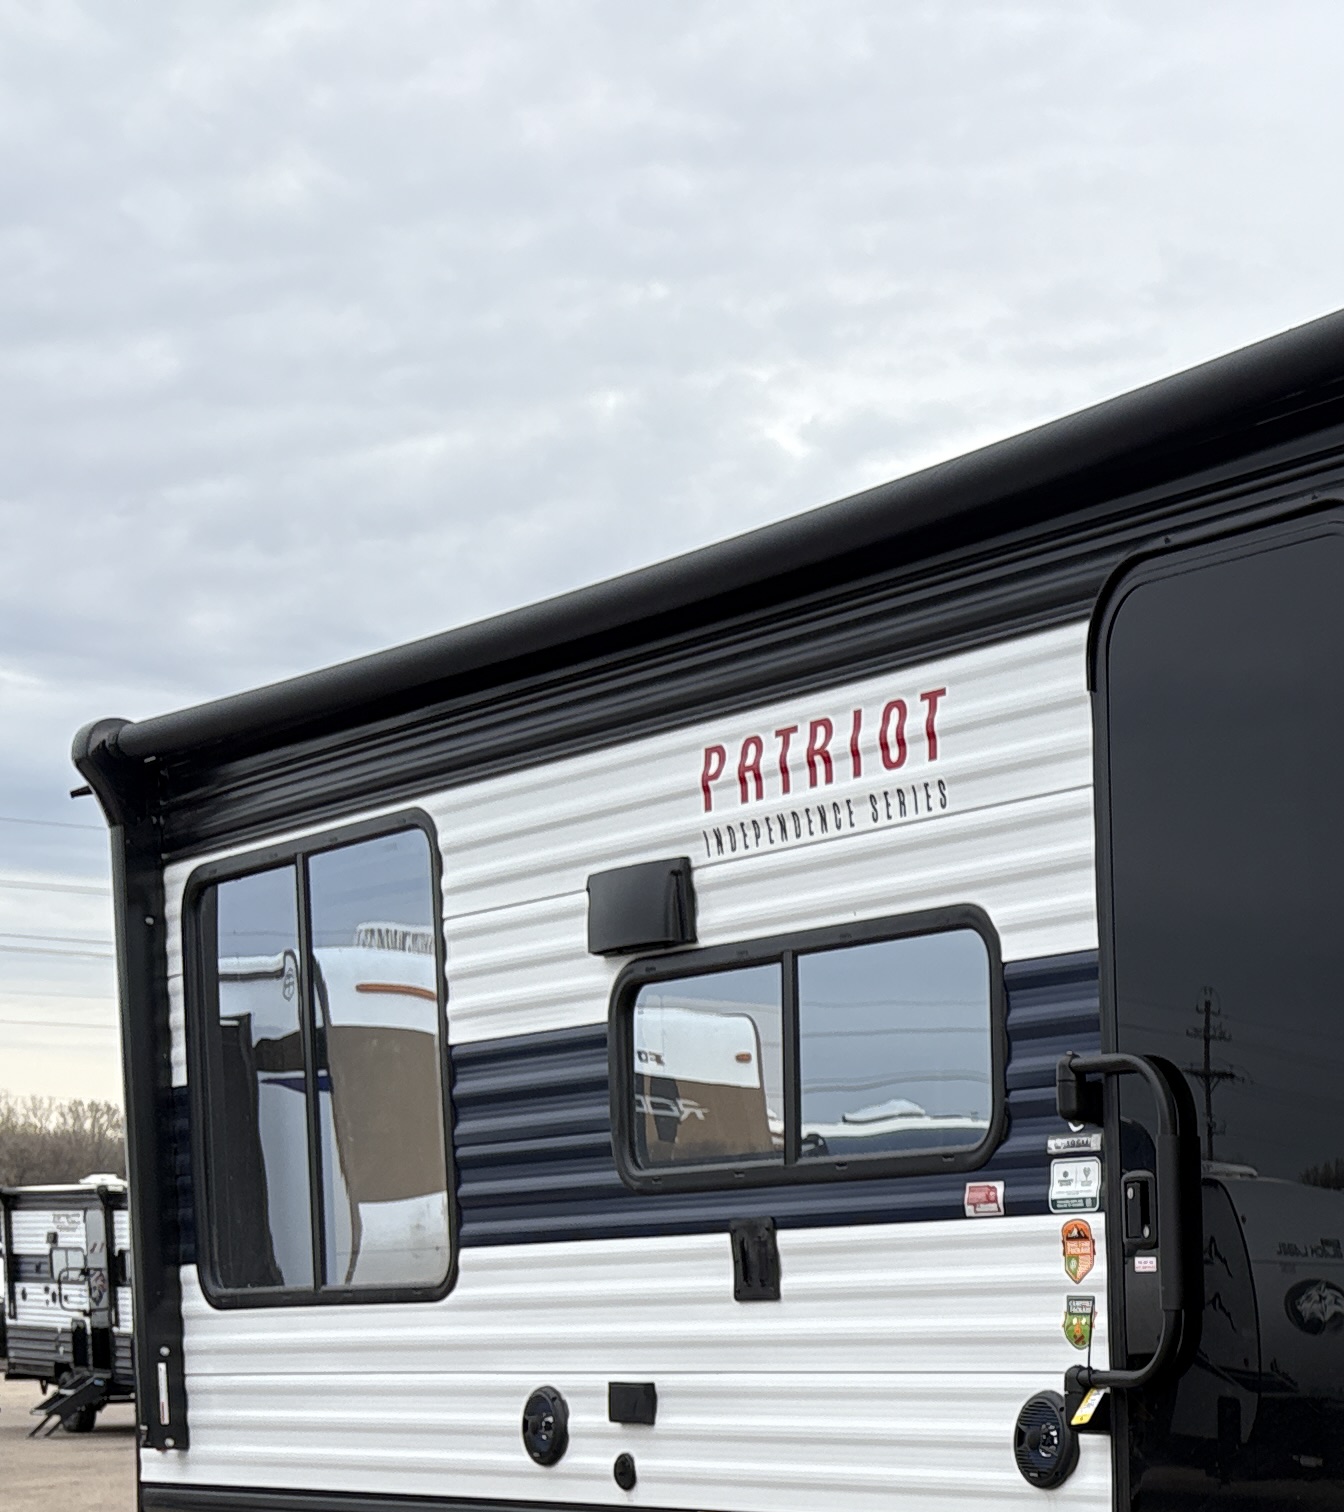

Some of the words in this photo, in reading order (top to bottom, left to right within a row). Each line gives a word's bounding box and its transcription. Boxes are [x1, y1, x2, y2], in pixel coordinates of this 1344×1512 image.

[702, 688, 947, 812] PATRIOT
[703, 799, 856, 858] INDEPENDENCE
[871, 779, 949, 822] SERIES
